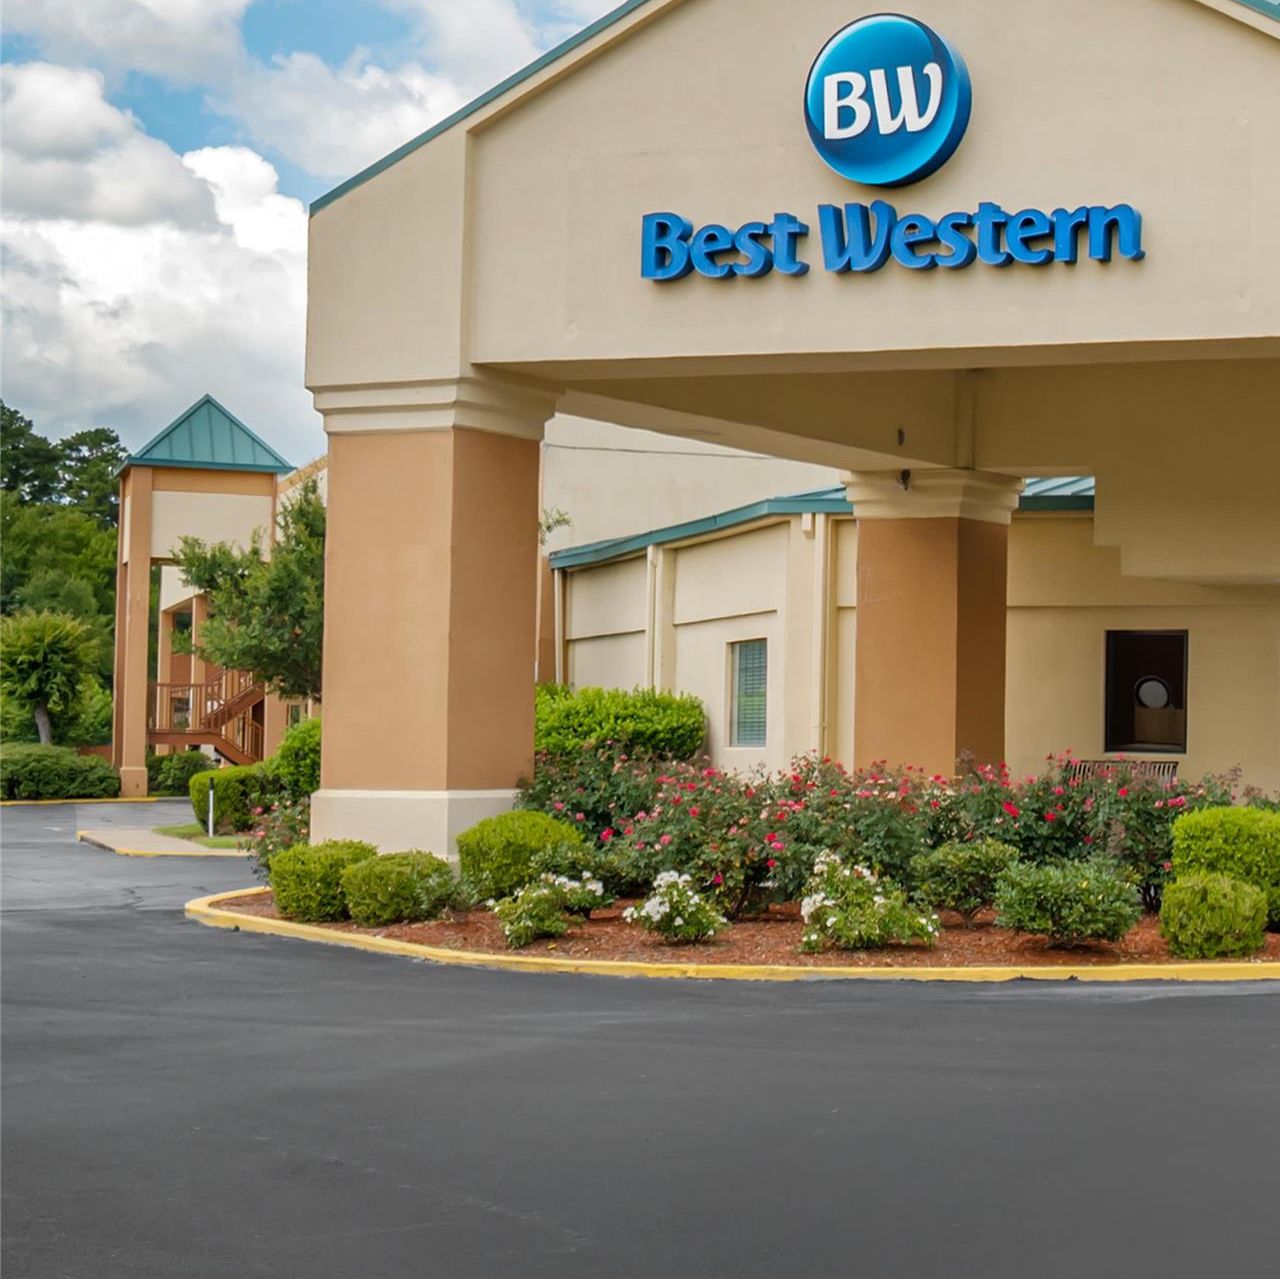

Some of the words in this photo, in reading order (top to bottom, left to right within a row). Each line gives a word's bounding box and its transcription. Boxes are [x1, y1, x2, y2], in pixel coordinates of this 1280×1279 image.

[823, 62, 942, 140] BW
[641, 212, 810, 280] Best
[817, 200, 1145, 273] Western
